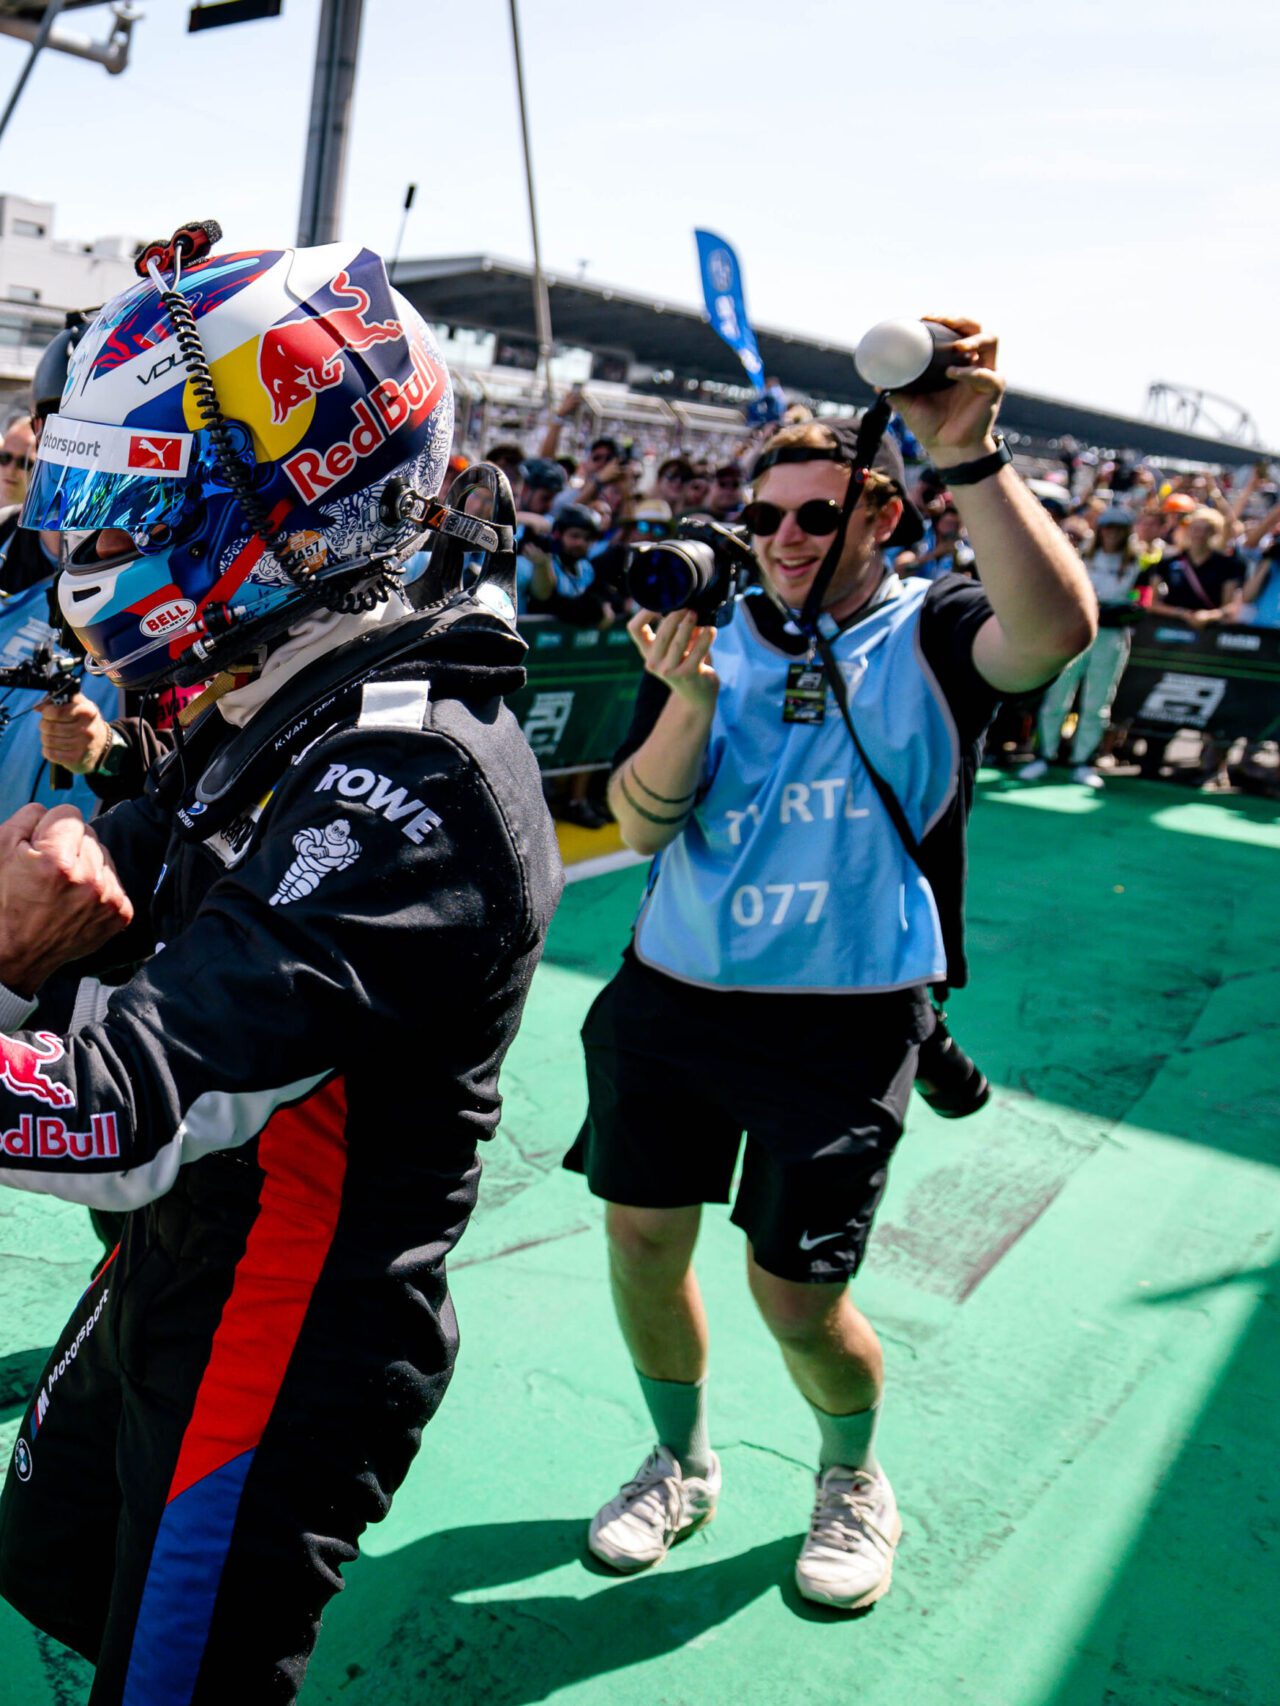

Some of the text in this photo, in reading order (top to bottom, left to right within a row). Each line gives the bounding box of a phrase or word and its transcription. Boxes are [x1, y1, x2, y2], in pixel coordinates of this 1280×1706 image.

[43, 431, 101, 457] otorsport
[282, 339, 438, 505] Red Bull
[146, 605, 188, 632] BELL
[314, 763, 443, 845] ROWE
[780, 778, 869, 824] RTL
[731, 880, 830, 927] 077
[36, 1110, 120, 1157] Bull
[48, 1288, 109, 1392] Motorsport
